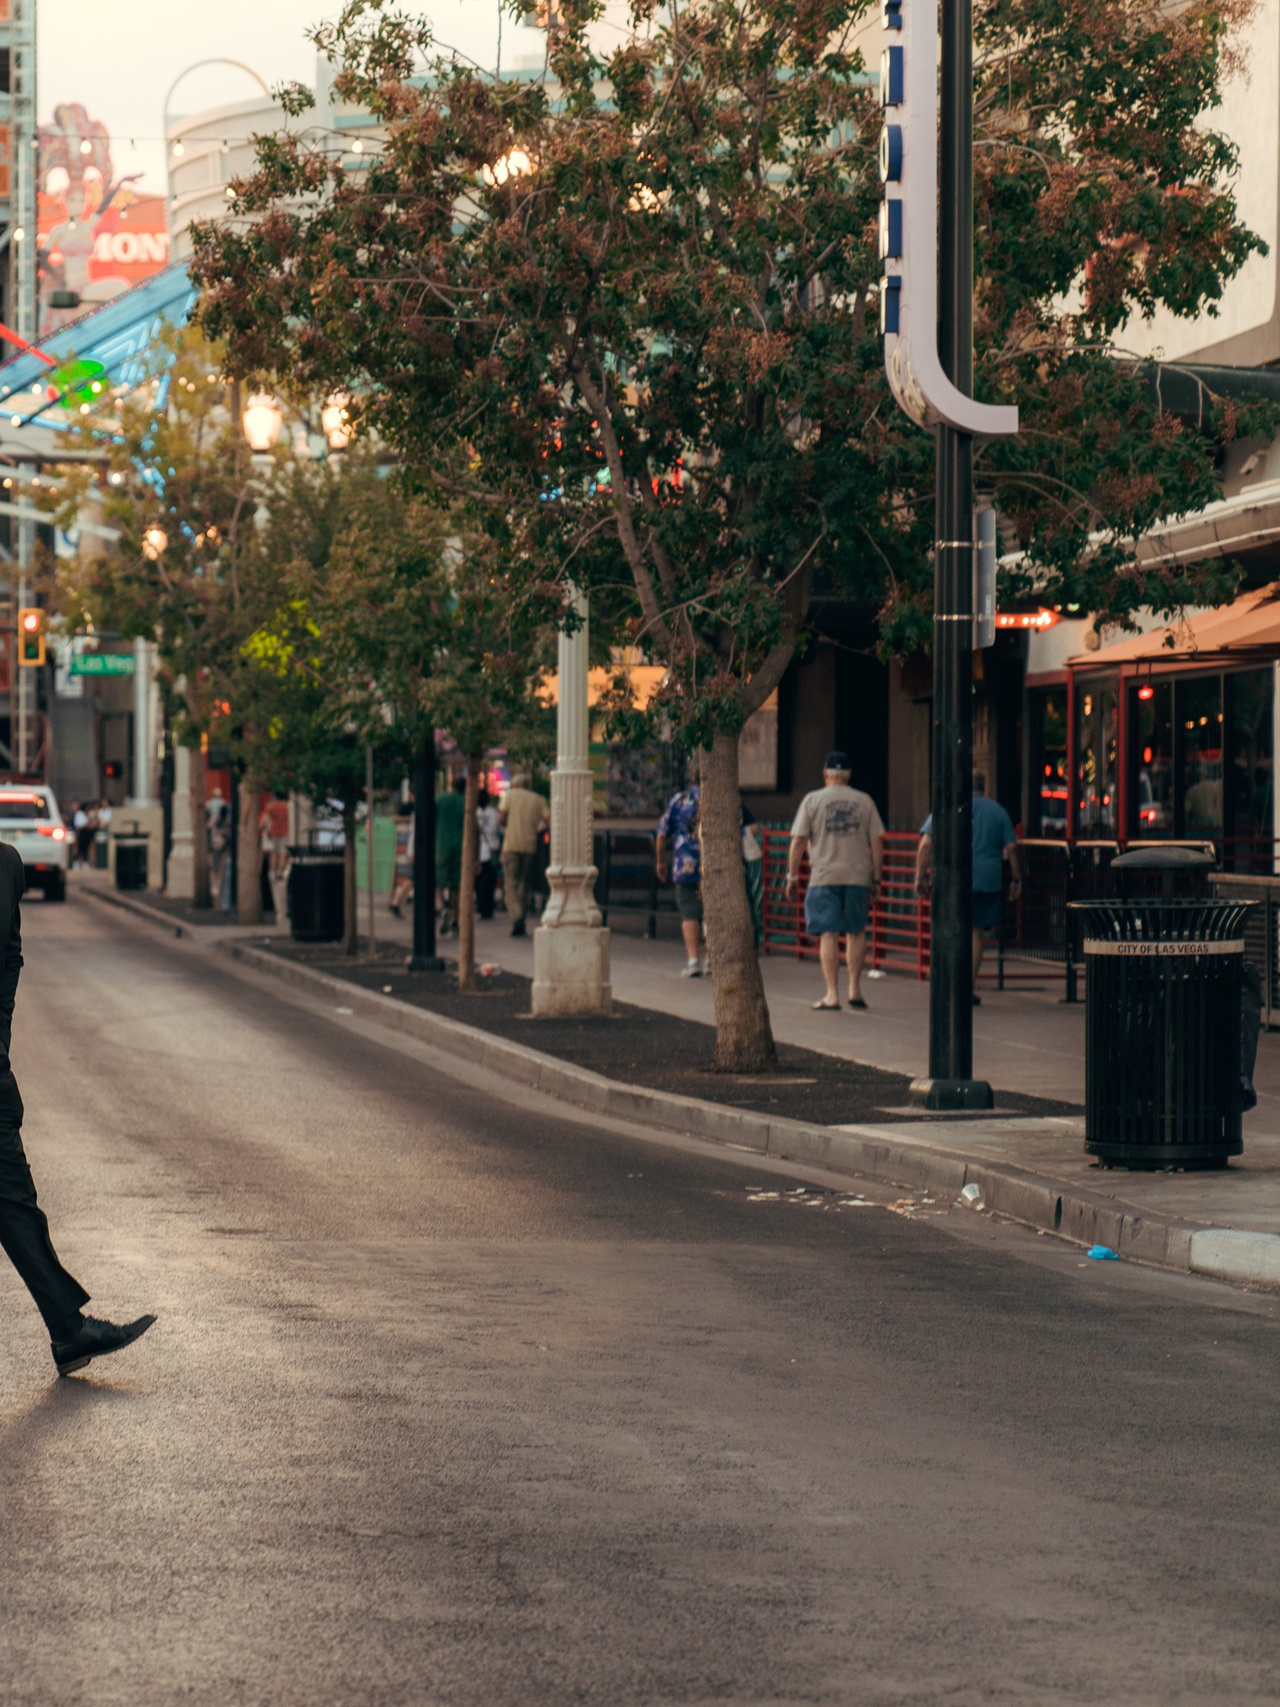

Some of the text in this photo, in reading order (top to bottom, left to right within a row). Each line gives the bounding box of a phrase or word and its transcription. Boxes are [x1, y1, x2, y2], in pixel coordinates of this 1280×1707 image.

[1117, 944, 1138, 953] CITY
[1139, 944, 1153, 953] OF
[1177, 943, 1209, 953] VEGAS
